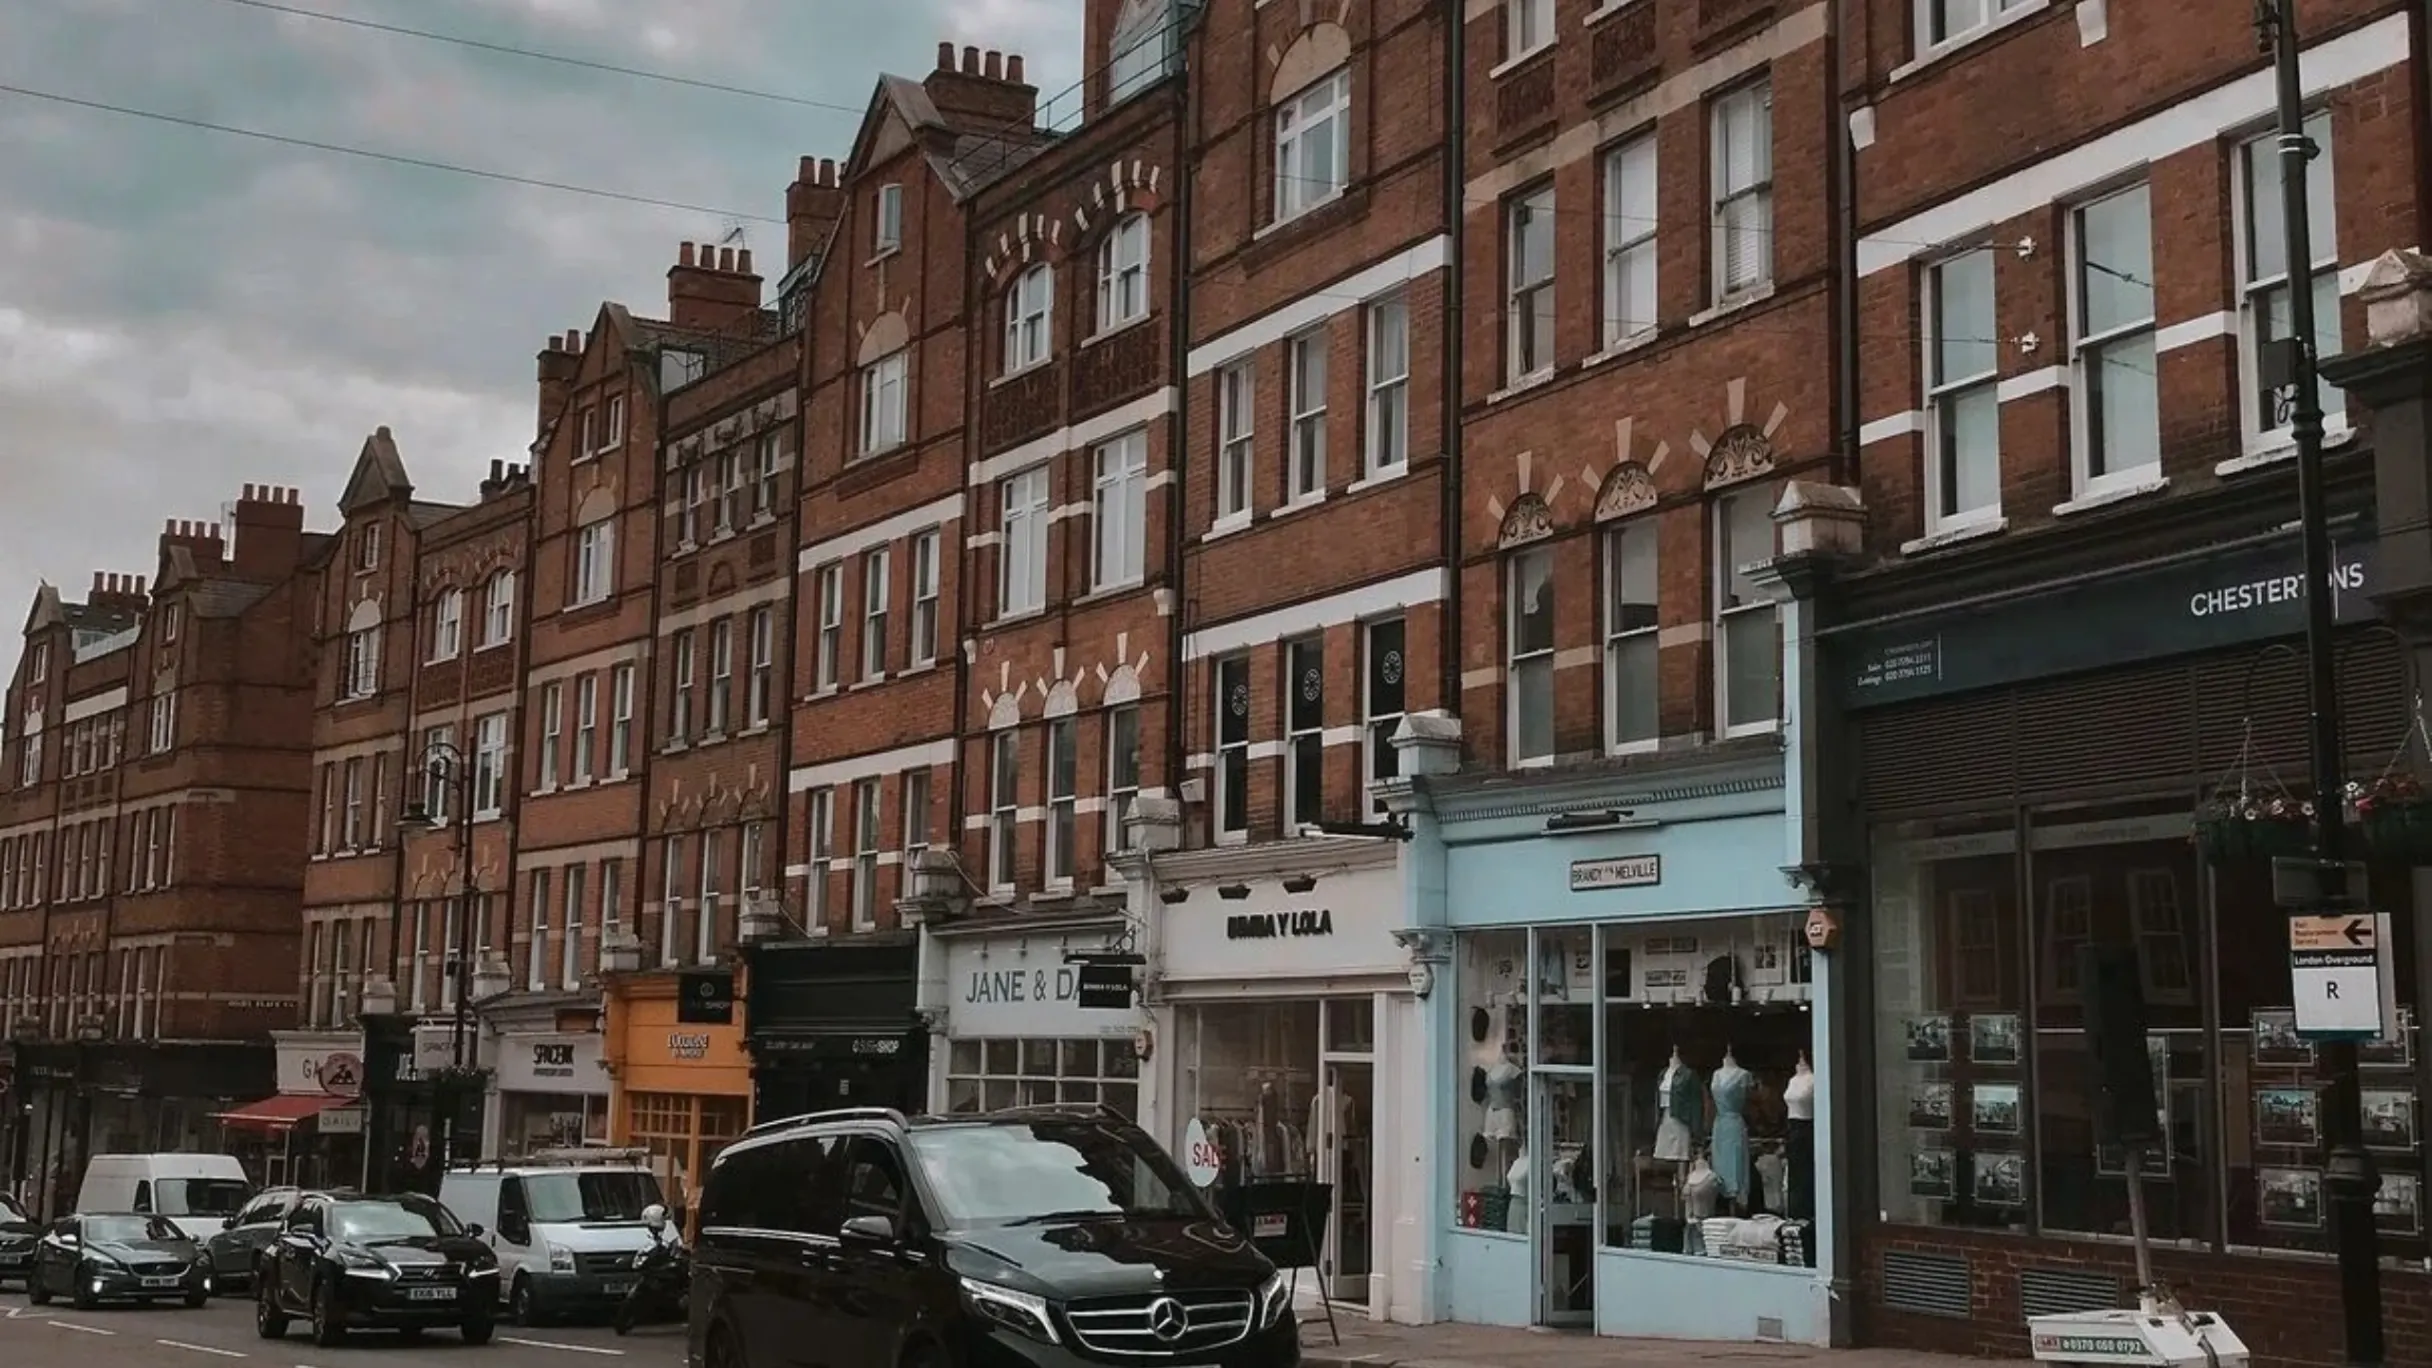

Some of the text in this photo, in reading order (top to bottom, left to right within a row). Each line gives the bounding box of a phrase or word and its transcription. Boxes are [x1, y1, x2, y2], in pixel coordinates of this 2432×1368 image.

[2190, 562, 2364, 616] CHESTERTNS
[1614, 862, 1656, 880] MELVILLE
[1277, 912, 1289, 936] Y
[1292, 910, 1333, 935] LOLA
[2295, 954, 2374, 966] London Overground
[966, 971, 1026, 1003] JANE
[1033, 969, 1047, 1001] &
[2326, 981, 2340, 1000] R
[1193, 1142, 1227, 1171] SALE
